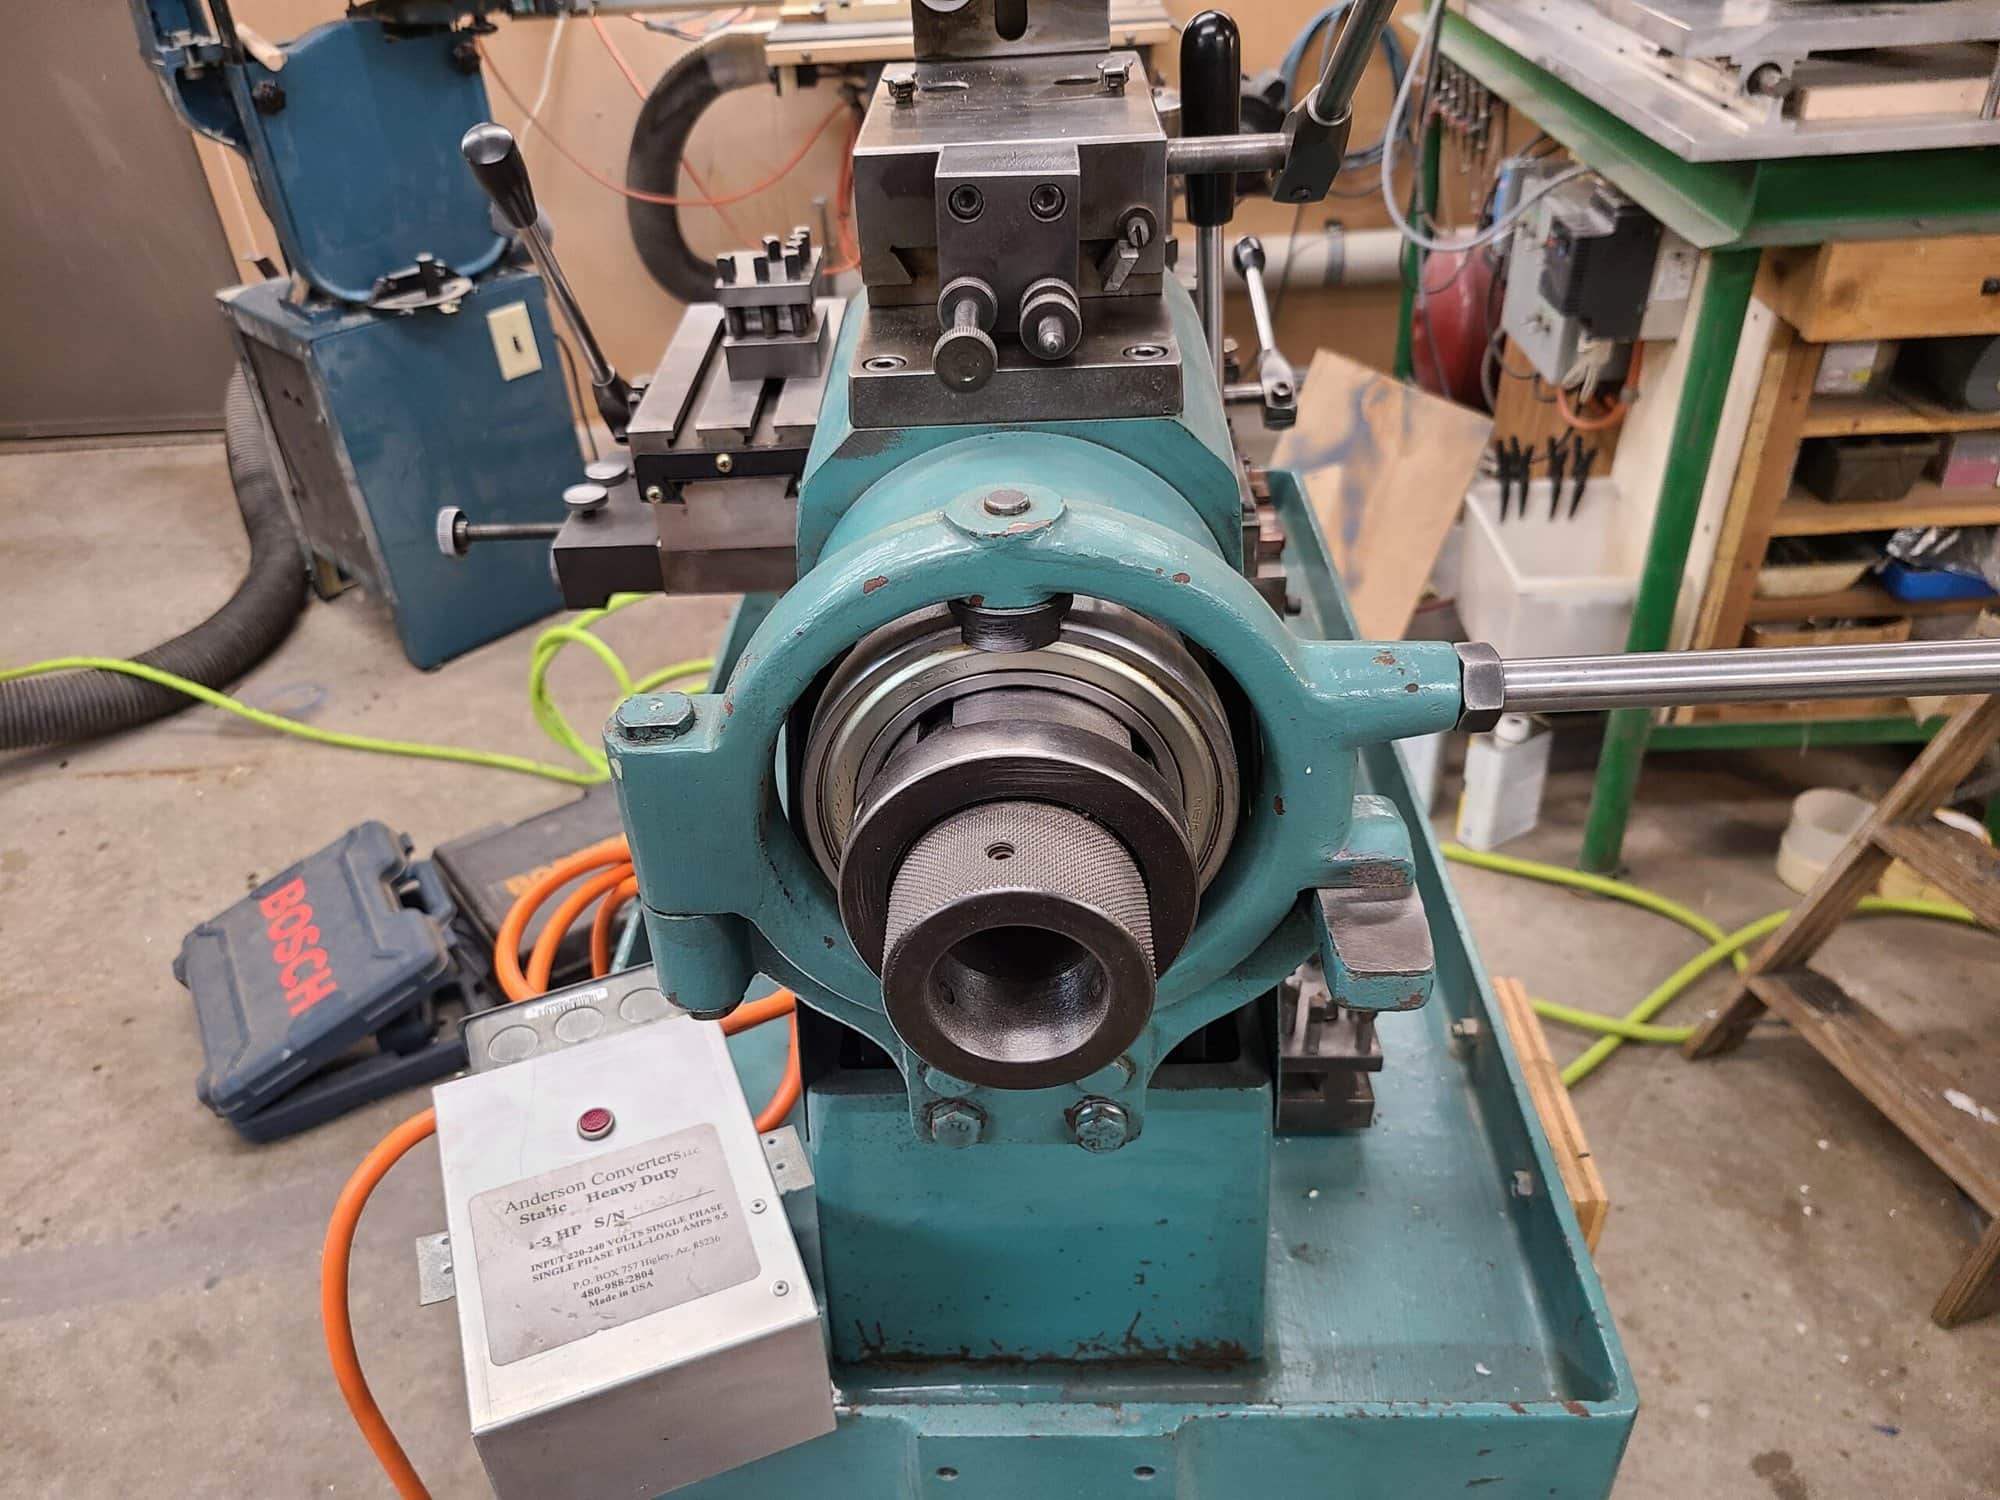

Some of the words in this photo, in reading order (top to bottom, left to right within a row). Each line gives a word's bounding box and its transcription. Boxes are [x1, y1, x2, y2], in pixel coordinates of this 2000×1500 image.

[259, 877, 337, 1016] BOSCH
[505, 1181, 586, 1215] Anderson
[519, 1203, 567, 1225] Static
[586, 1180, 637, 1203] Heavy
[641, 1167, 679, 1186] Duty
[530, 1254, 565, 1272] INPUT
[606, 1230, 646, 1246] VOLTS
[646, 1215, 686, 1234] SINGLE
[689, 1202, 724, 1220] PHASE
[556, 1224, 582, 1241] HP
[594, 1209, 625, 1229] S/N
[532, 1262, 575, 1282] SINGLE
[577, 1248, 614, 1268] PHASE
[616, 1229, 680, 1255] FULL-LOAD
[683, 1219, 713, 1233] AMPS
[595, 1268, 619, 1283] BOX
[621, 1262, 638, 1274] 757
[588, 1294, 617, 1308] Made
[631, 1280, 654, 1293] USA
